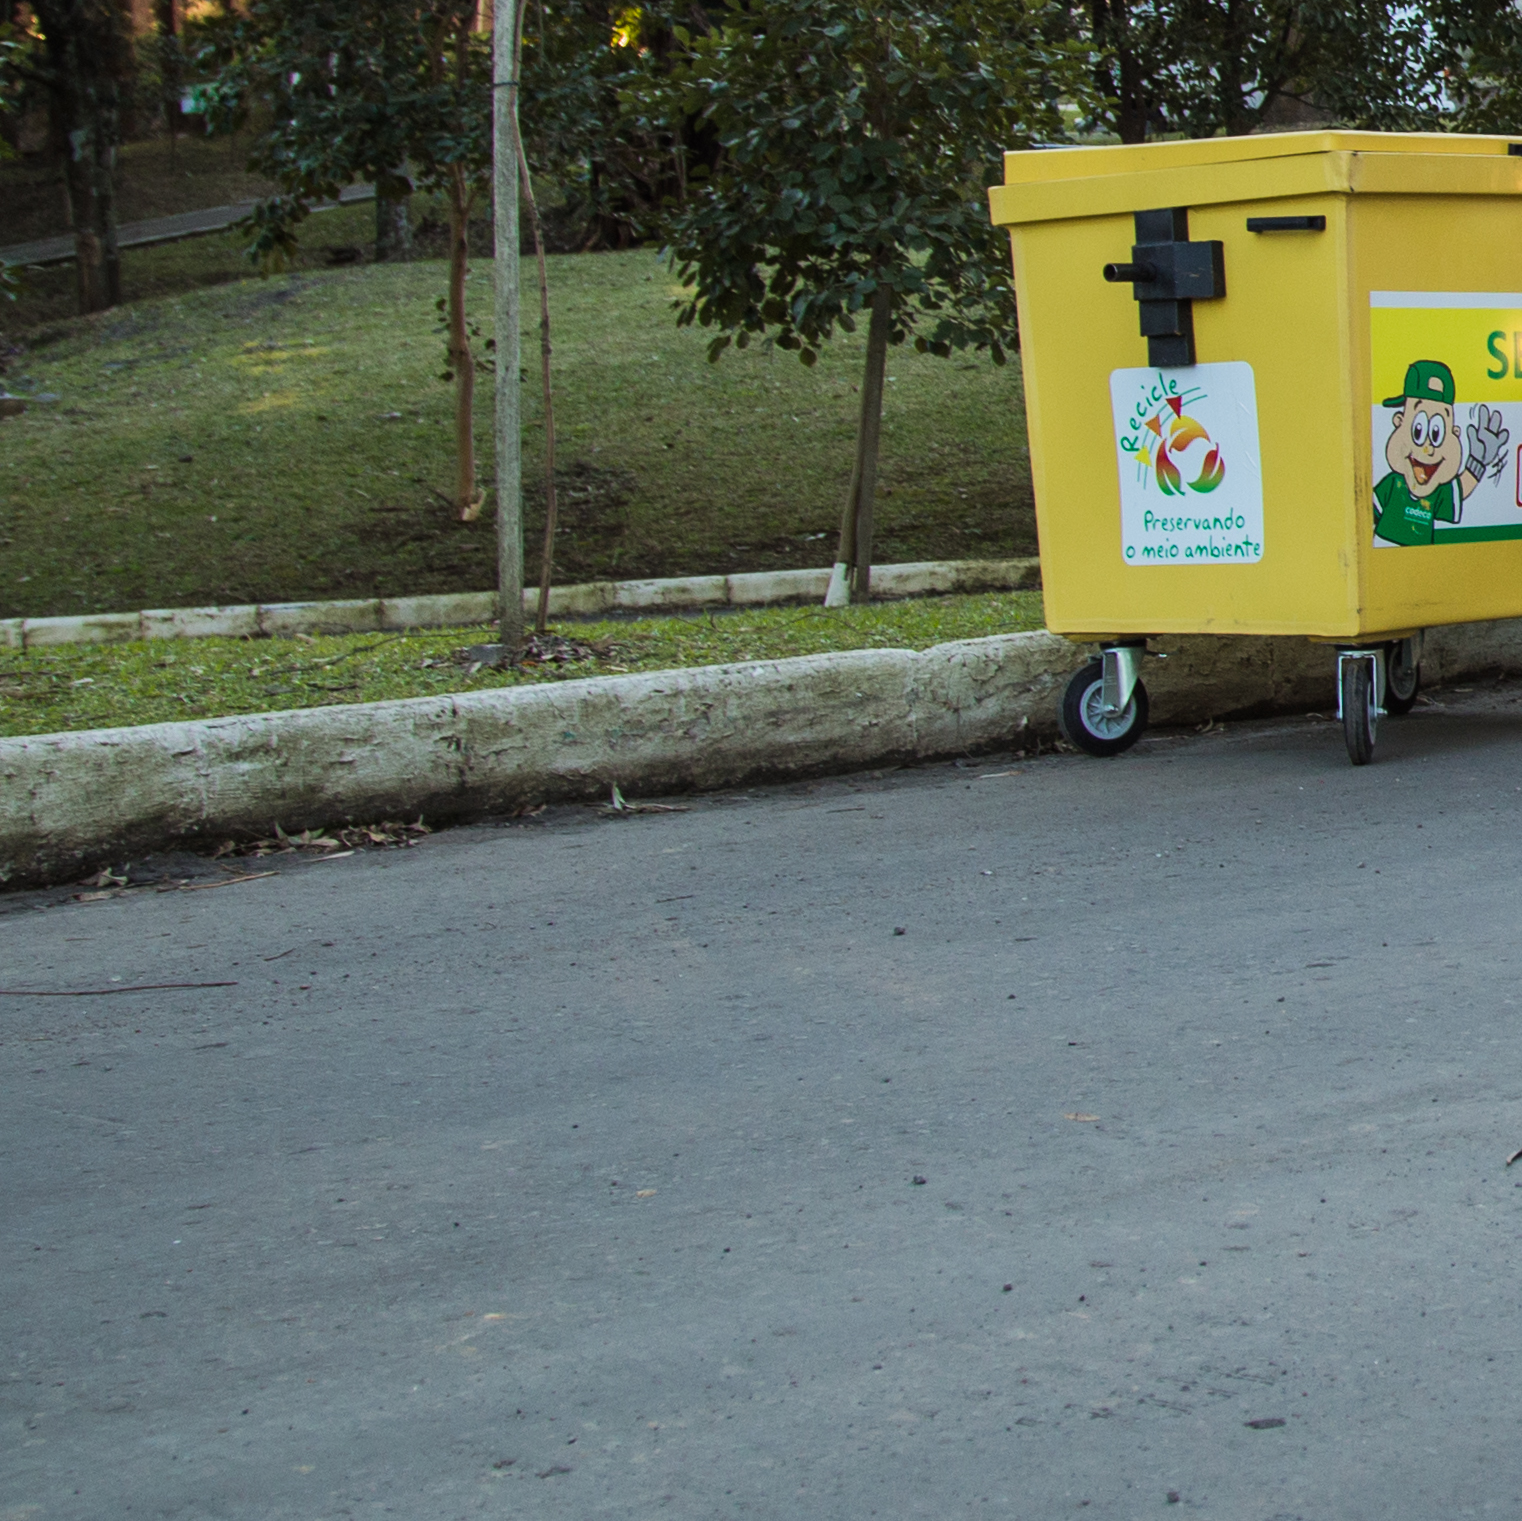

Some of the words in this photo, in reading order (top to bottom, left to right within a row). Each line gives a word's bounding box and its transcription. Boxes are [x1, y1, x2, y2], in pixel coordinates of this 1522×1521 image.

[1120, 372, 1178, 452] Recicle
[1144, 507, 1246, 532] Preservando
[1126, 545, 1136, 559] o
[1142, 538, 1179, 559] meio
[1184, 535, 1261, 558] ambiente
